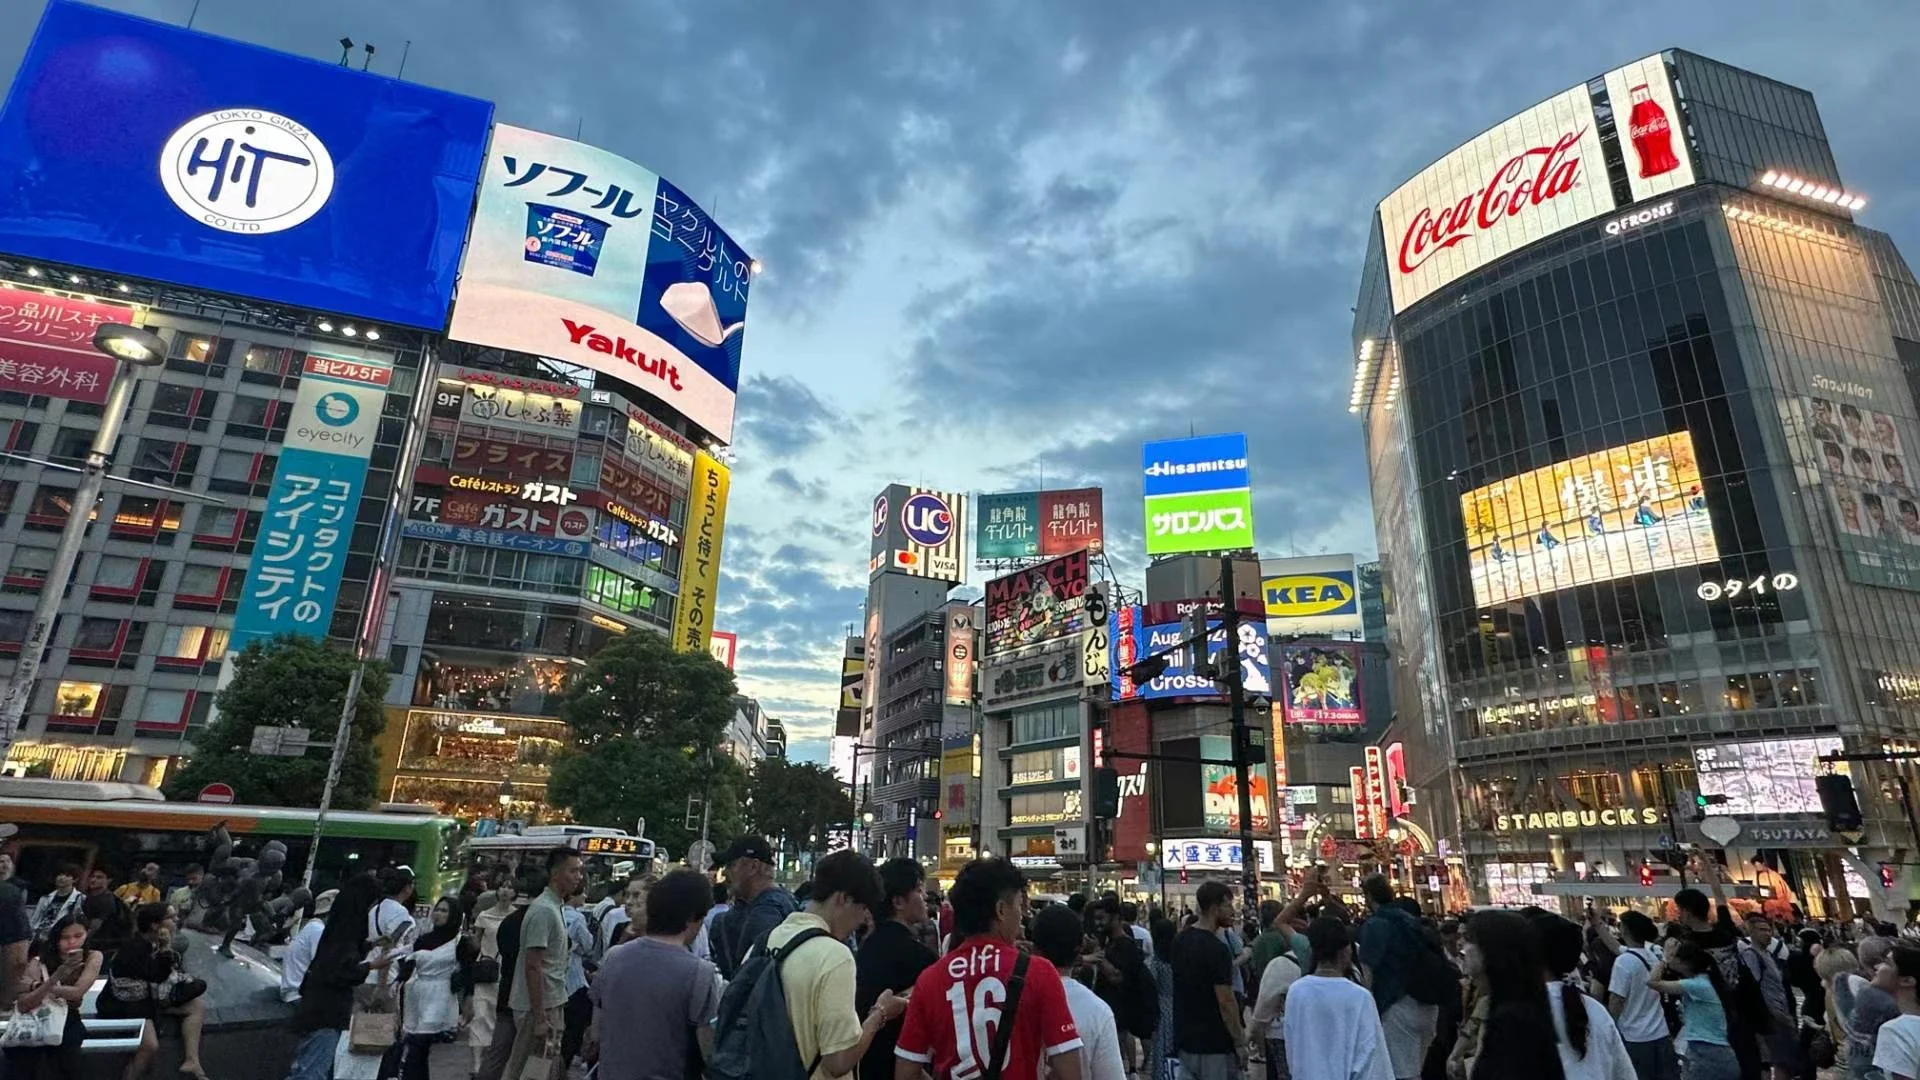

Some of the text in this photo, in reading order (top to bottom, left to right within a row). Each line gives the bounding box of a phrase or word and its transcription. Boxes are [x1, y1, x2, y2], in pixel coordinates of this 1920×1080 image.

[212, 110, 310, 141] TOKYO GINZA
[503, 155, 643, 219] ソフール
[1400, 124, 1589, 274] Coca-Cola
[537, 221, 595, 246] ソフール
[1605, 202, 1674, 236] QFRONT
[656, 191, 750, 285] ヤクルトの
[651, 212, 747, 302] ヨーグルト
[560, 317, 683, 392] Yakult
[0, 358, 99, 392] 美容外科
[314, 360, 383, 380] 当ビル5F
[437, 392, 460, 407] 9F
[297, 427, 365, 448] eyecity
[457, 441, 567, 472] プライス
[1144, 458, 1248, 477] Hisamitsu
[412, 496, 442, 514] 7F
[521, 482, 577, 506] ガスト
[479, 503, 551, 532] ガスト
[647, 518, 679, 547] ガスト
[908, 504, 949, 535] UC
[1152, 507, 1246, 537] サロンパス
[255, 474, 321, 620] アイシティ
[293, 479, 350, 623] コンタクトの
[933, 560, 956, 570] VISA
[988, 552, 1086, 602] MACH
[1265, 584, 1346, 605] KEA
[1084, 586, 1109, 681] もんじゃ
[1546, 695, 1597, 709] LOUNGE
[1695, 748, 1718, 761] 3F
[1497, 807, 1658, 830] STARBUCKS
[1751, 828, 1829, 841] TSUTAYA
[948, 944, 1001, 979] elfi
[945, 976, 1012, 1079] 16
